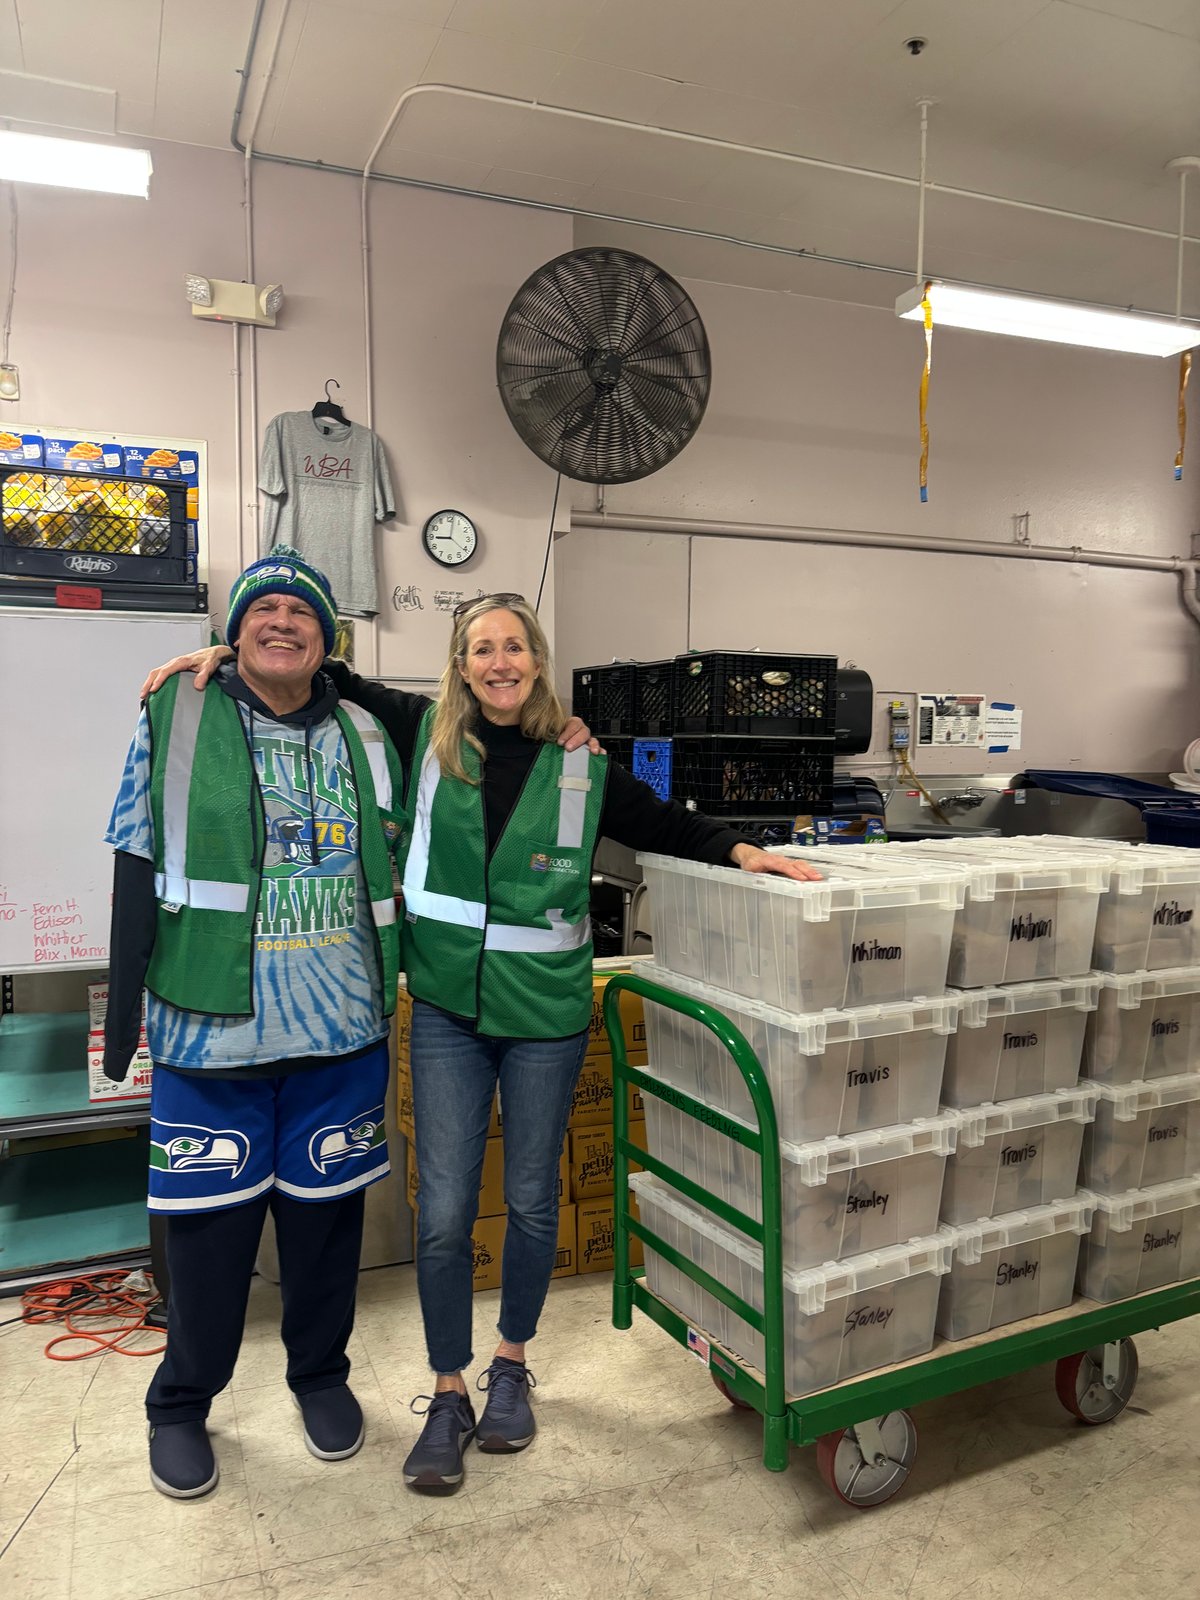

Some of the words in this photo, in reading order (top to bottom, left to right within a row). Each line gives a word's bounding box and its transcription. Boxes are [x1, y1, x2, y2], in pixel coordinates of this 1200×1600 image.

[70, 557, 111, 572] Ralphs
[253, 736, 358, 822] TTLE
[315, 823, 346, 845] 76
[550, 858, 572, 868] FOOD
[255, 876, 357, 935] HAWKS
[33, 914, 83, 930] Edison
[257, 938, 316, 951] FOOTBALL
[318, 933, 351, 946] LEAGUE
[852, 939, 901, 963] Whitman
[1151, 1018, 1181, 1037] Travis
[1003, 1032, 1038, 1051] Travis
[133, 1061, 153, 1069] ORGA
[847, 1066, 890, 1088] Travis
[1148, 1125, 1179, 1143] Travis
[1000, 1145, 1038, 1167] Travis
[846, 1191, 889, 1215] Stanley
[1143, 1229, 1181, 1252] Stanley
[996, 1261, 1038, 1287] Stanley
[843, 1306, 894, 1338] Stanley
